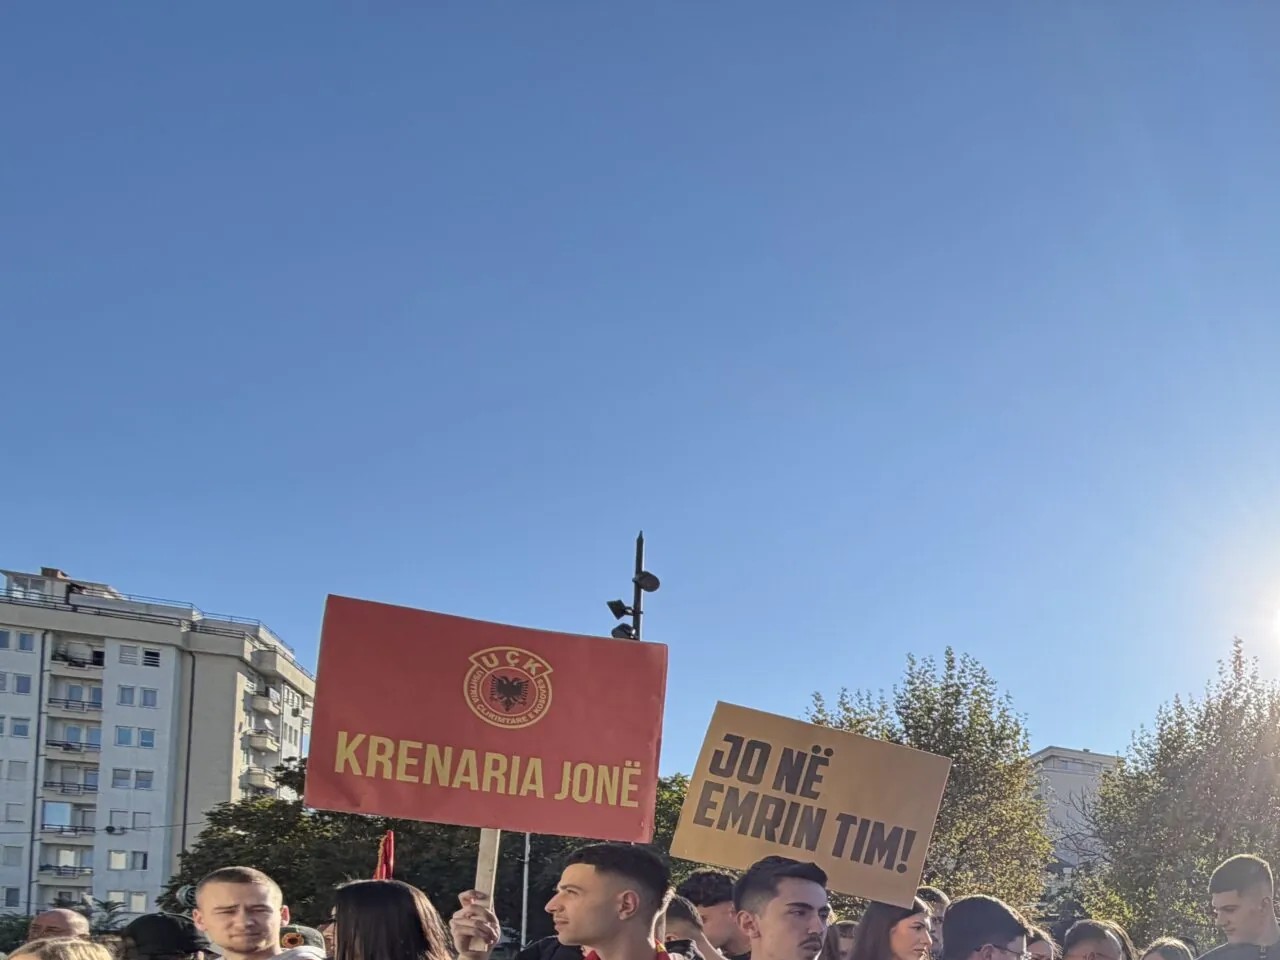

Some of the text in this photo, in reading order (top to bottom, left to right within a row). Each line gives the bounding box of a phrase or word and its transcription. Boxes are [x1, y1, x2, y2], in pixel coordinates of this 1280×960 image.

[481, 651, 543, 676] UÇK
[334, 731, 642, 807] KRENARIA JONË
[709, 733, 834, 800] JO NË
[693, 780, 917, 874] EMRIN TIM!
